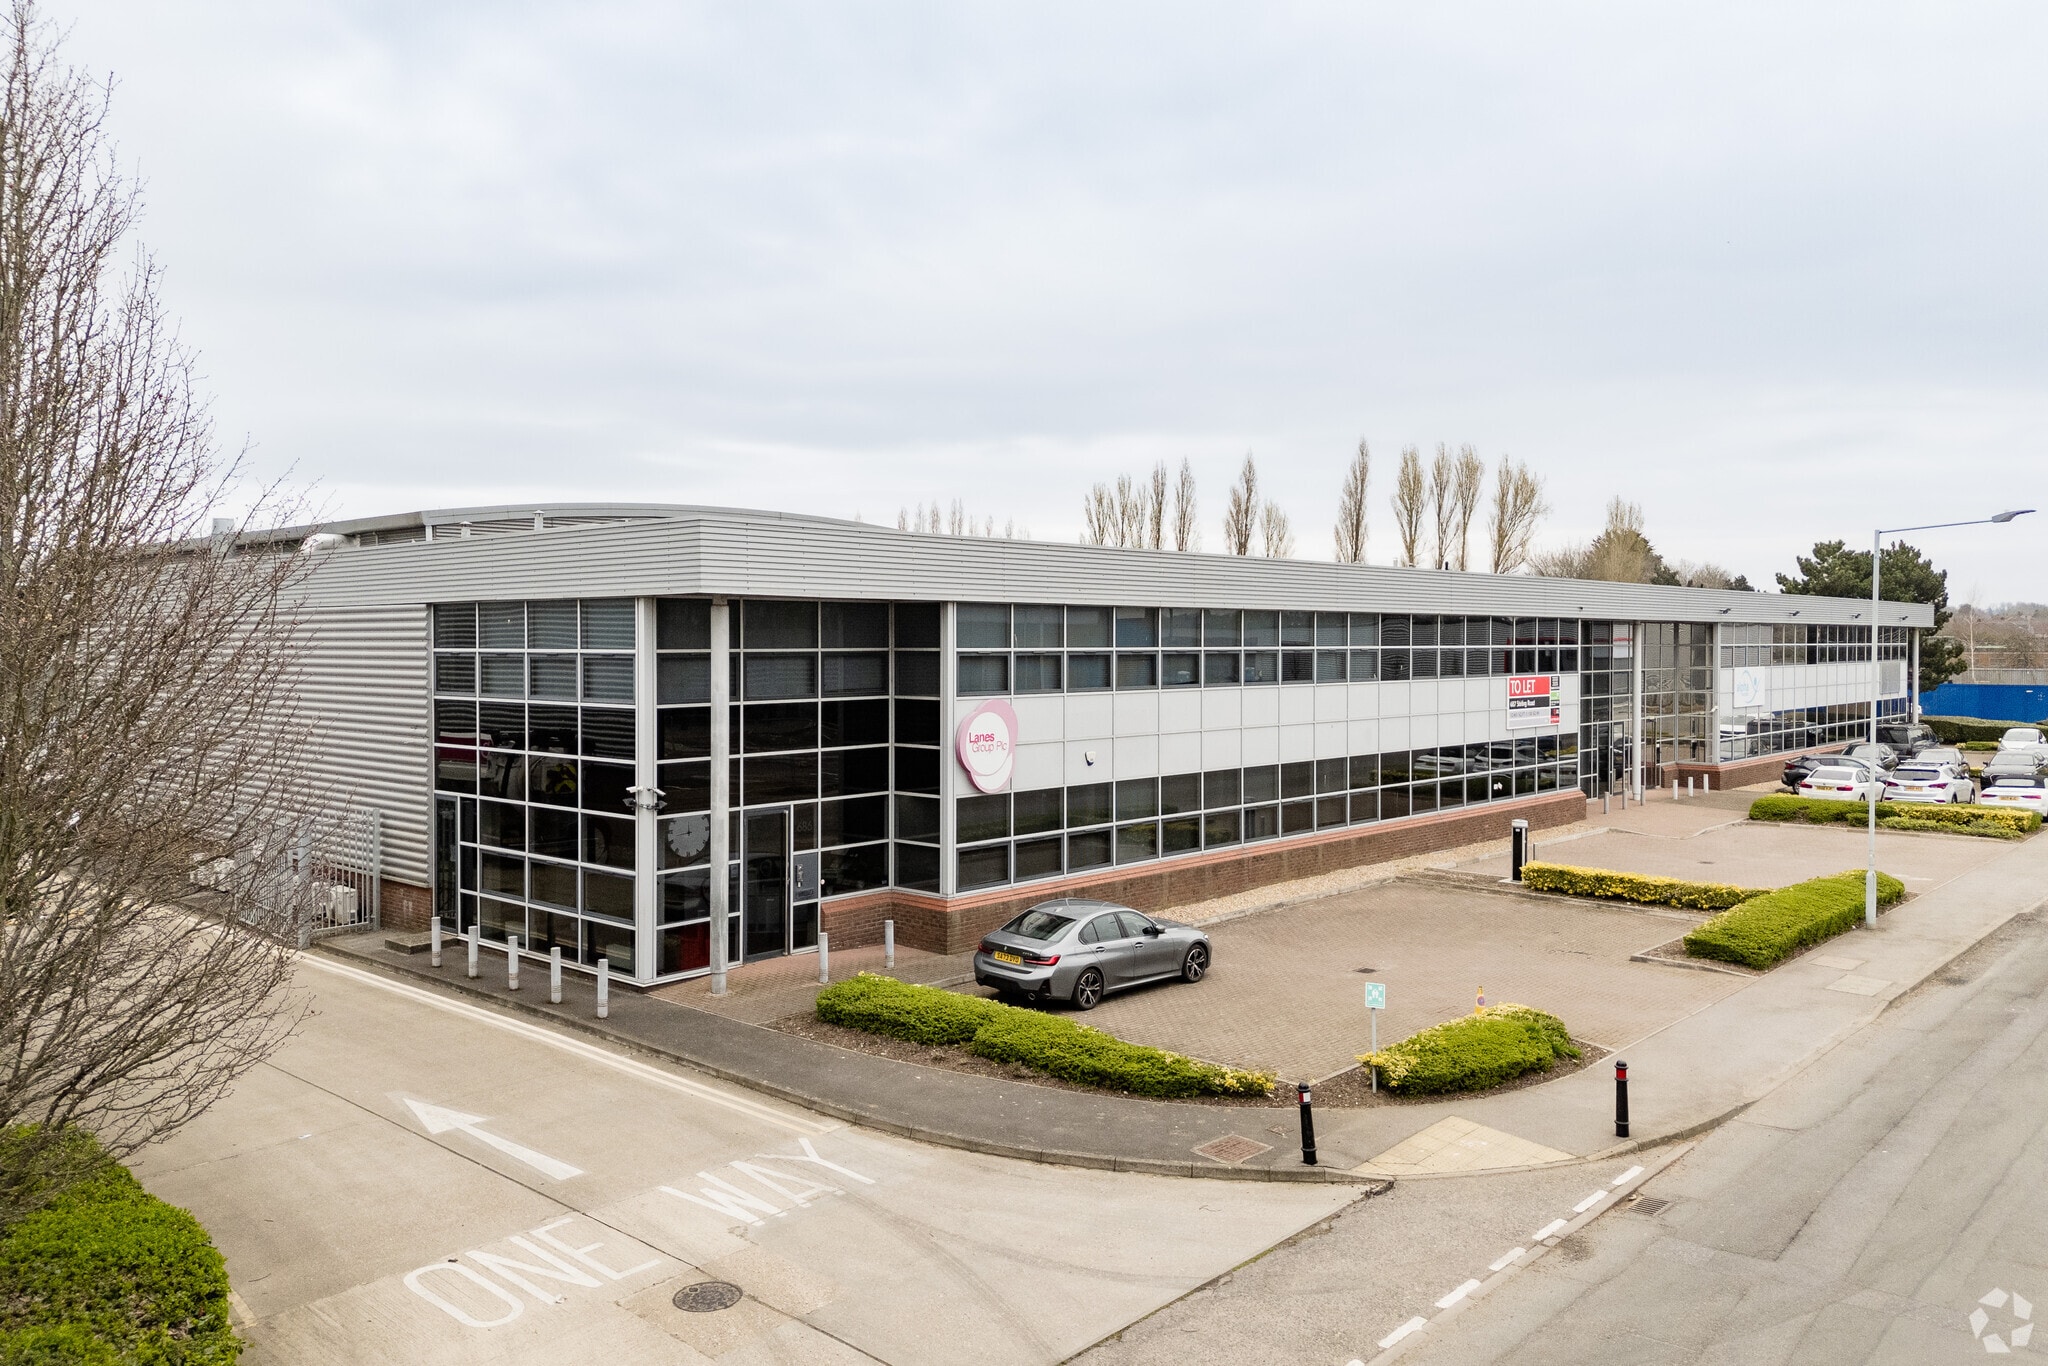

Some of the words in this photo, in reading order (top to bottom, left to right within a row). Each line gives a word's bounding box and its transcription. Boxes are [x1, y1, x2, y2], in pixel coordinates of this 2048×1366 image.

[1510, 680, 1521, 694] TO
[1522, 679, 1536, 693] LET
[969, 732, 995, 743] Lanes
[972, 742, 994, 754] Group
[797, 820, 812, 832] 686
[403, 1217, 662, 1328] ONE
[657, 1138, 876, 1226] WAY
